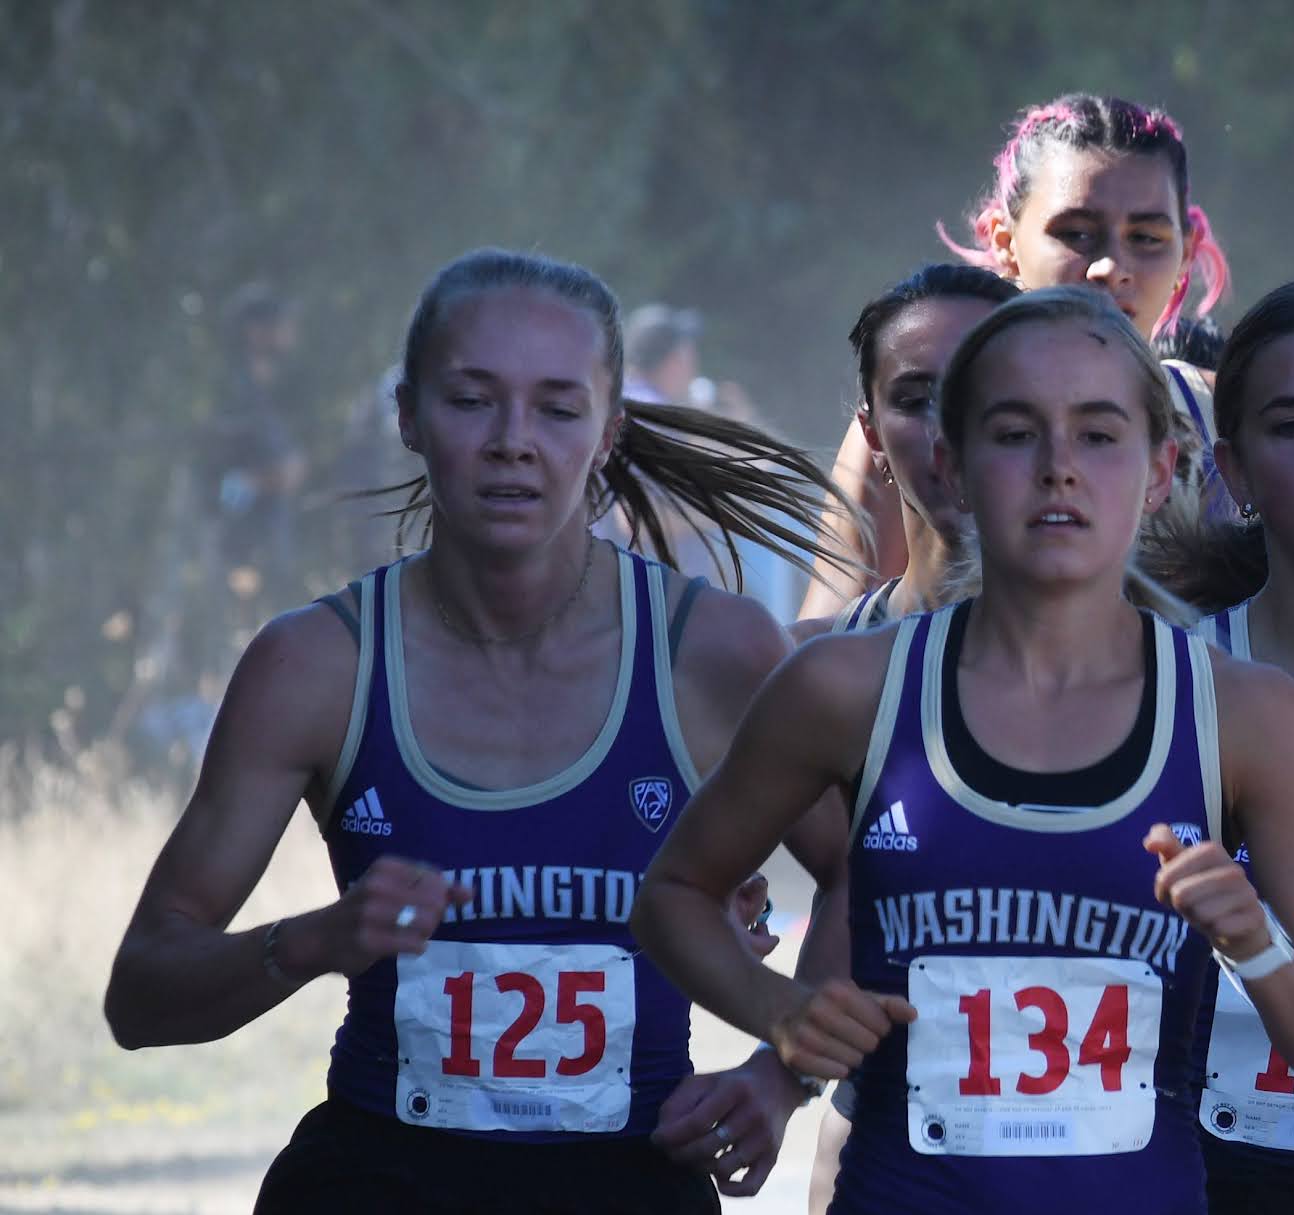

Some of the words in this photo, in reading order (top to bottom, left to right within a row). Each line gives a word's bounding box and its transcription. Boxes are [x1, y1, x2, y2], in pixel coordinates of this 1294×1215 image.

[634, 782, 668, 808] PAC
[644, 801, 662, 819] 12
[341, 816, 392, 836] adidas
[863, 832, 918, 851] adidas
[438, 865, 645, 923] HINGTO
[875, 888, 1189, 974] WASHINGTON
[441, 971, 607, 1078] 125
[958, 984, 1132, 1096] 134
